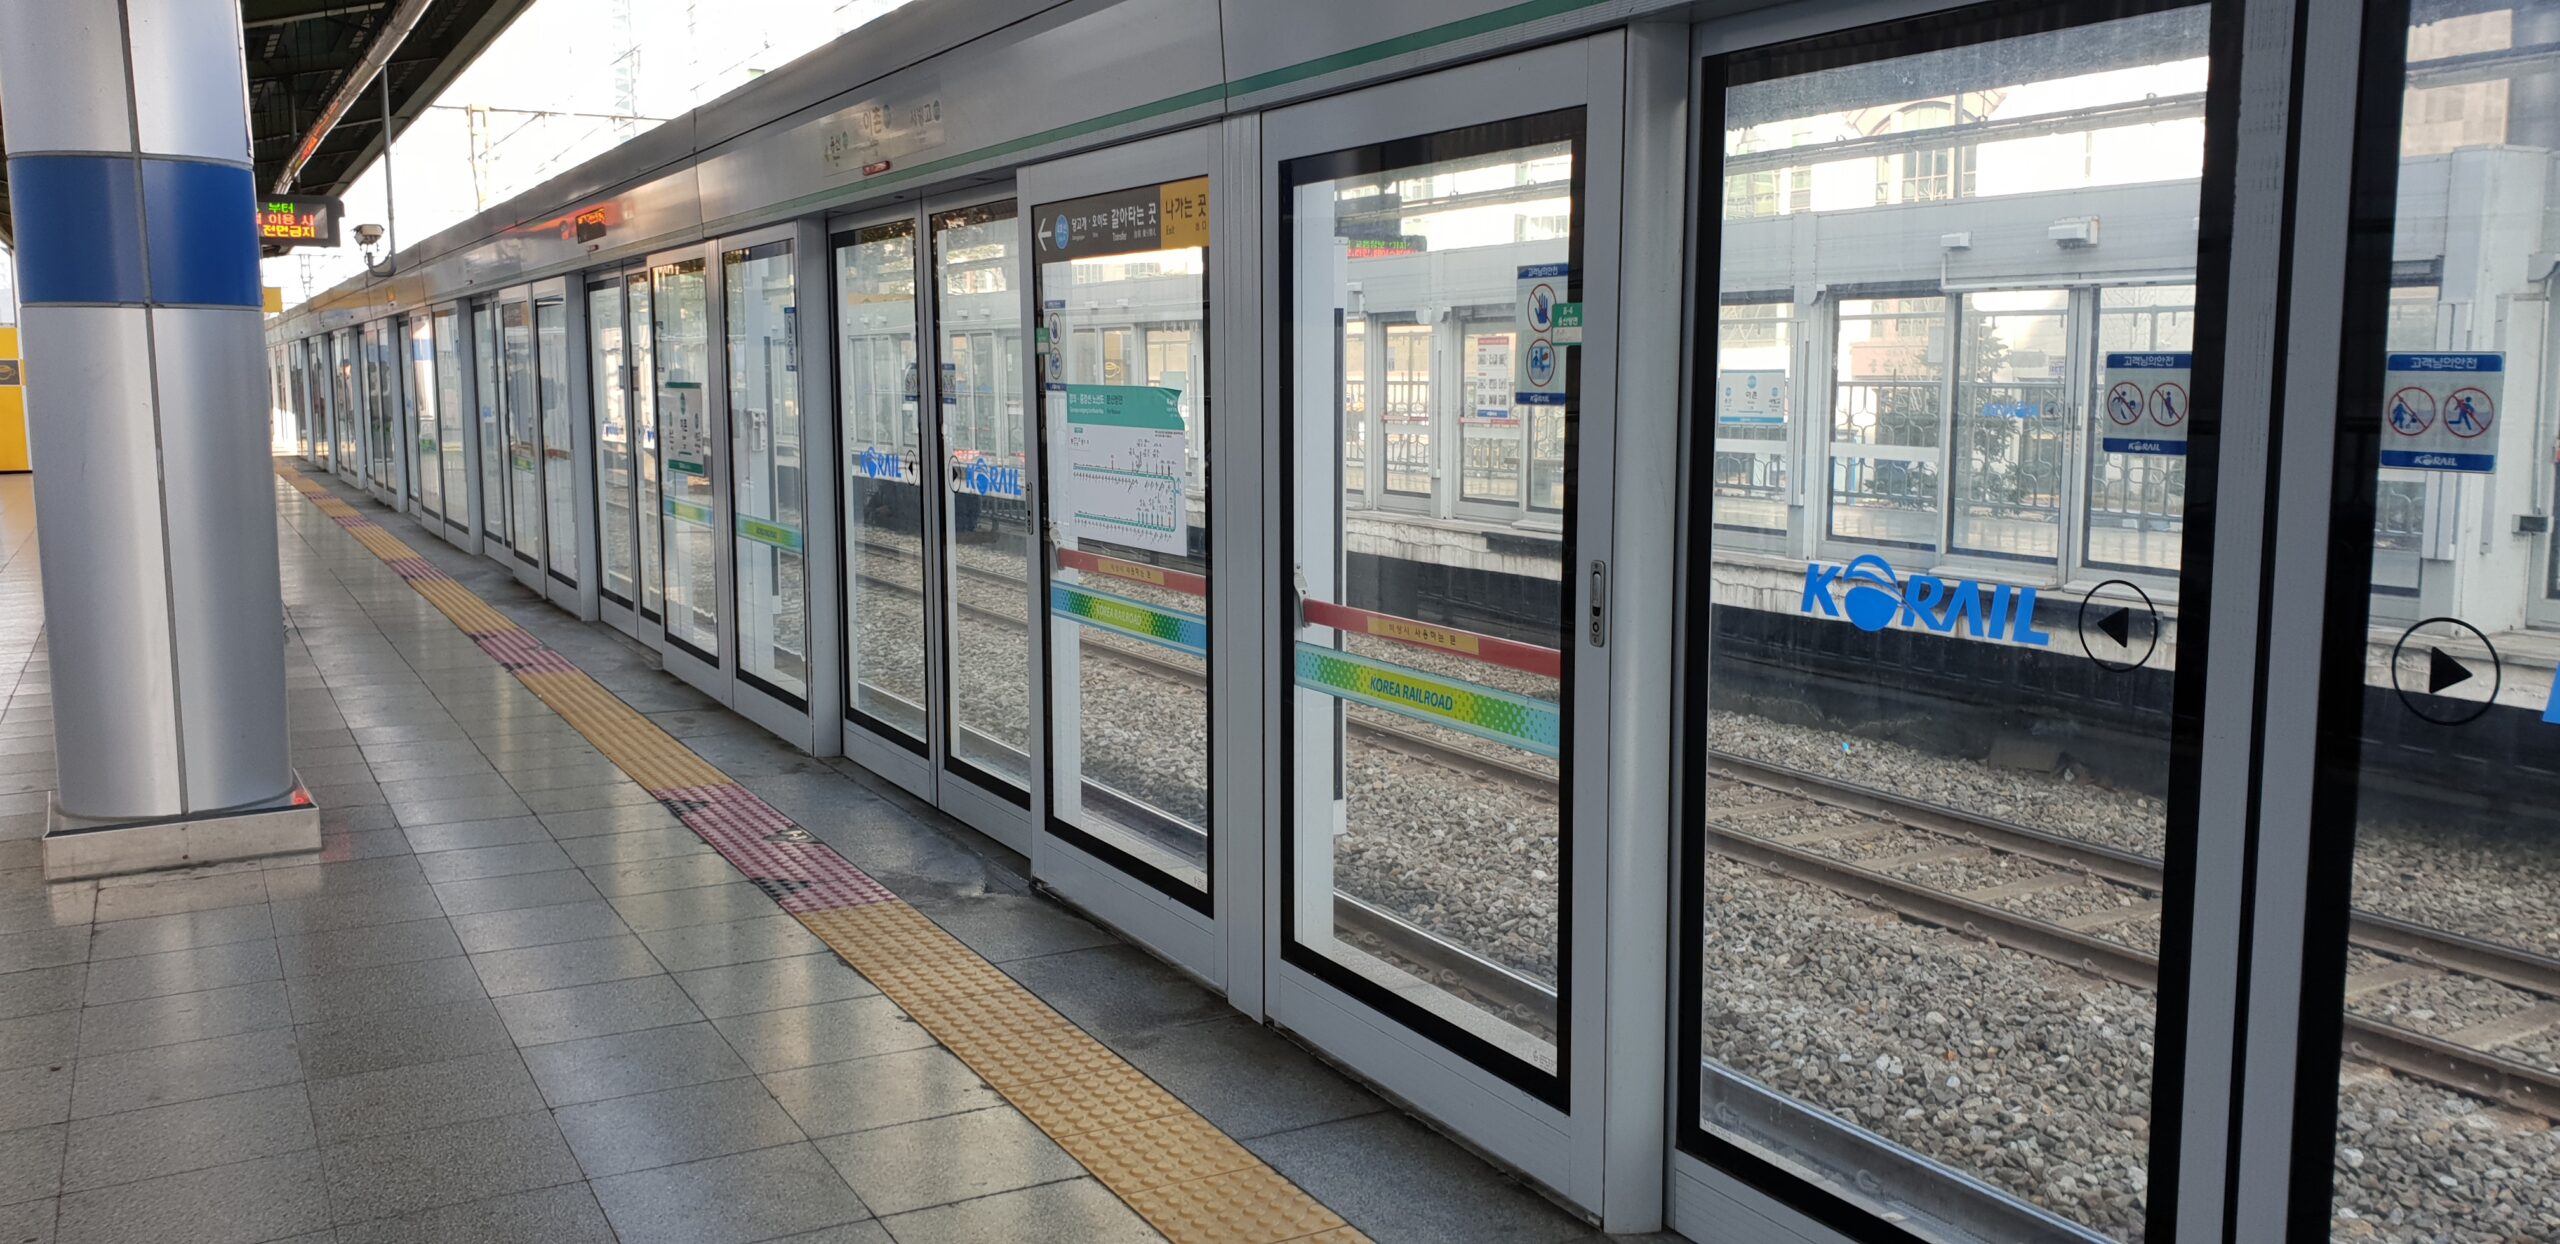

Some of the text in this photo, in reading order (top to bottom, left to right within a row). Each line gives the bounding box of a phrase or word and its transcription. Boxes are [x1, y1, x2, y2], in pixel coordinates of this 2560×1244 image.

[268, 203, 294, 213] 부터
[1165, 193, 1207, 220] 나가는 곳
[268, 214, 295, 225] 이용
[301, 215, 315, 225] 시
[1111, 205, 1145, 229] 갈아타는
[1148, 202, 1157, 225] 곳
[2123, 355, 2175, 367] 고객님의안전
[2410, 356, 2478, 369] 고객님의안전
[2128, 441, 2161, 452] KORAIL
[860, 447, 902, 480] KORAIL
[2414, 454, 2458, 466] KORAIL
[966, 458, 1022, 496] KORAIL
[1801, 554, 2050, 646] KORAIL
[1415, 629, 1444, 643] 사용하는
[1370, 675, 1454, 711] KOREA RAILROAD
